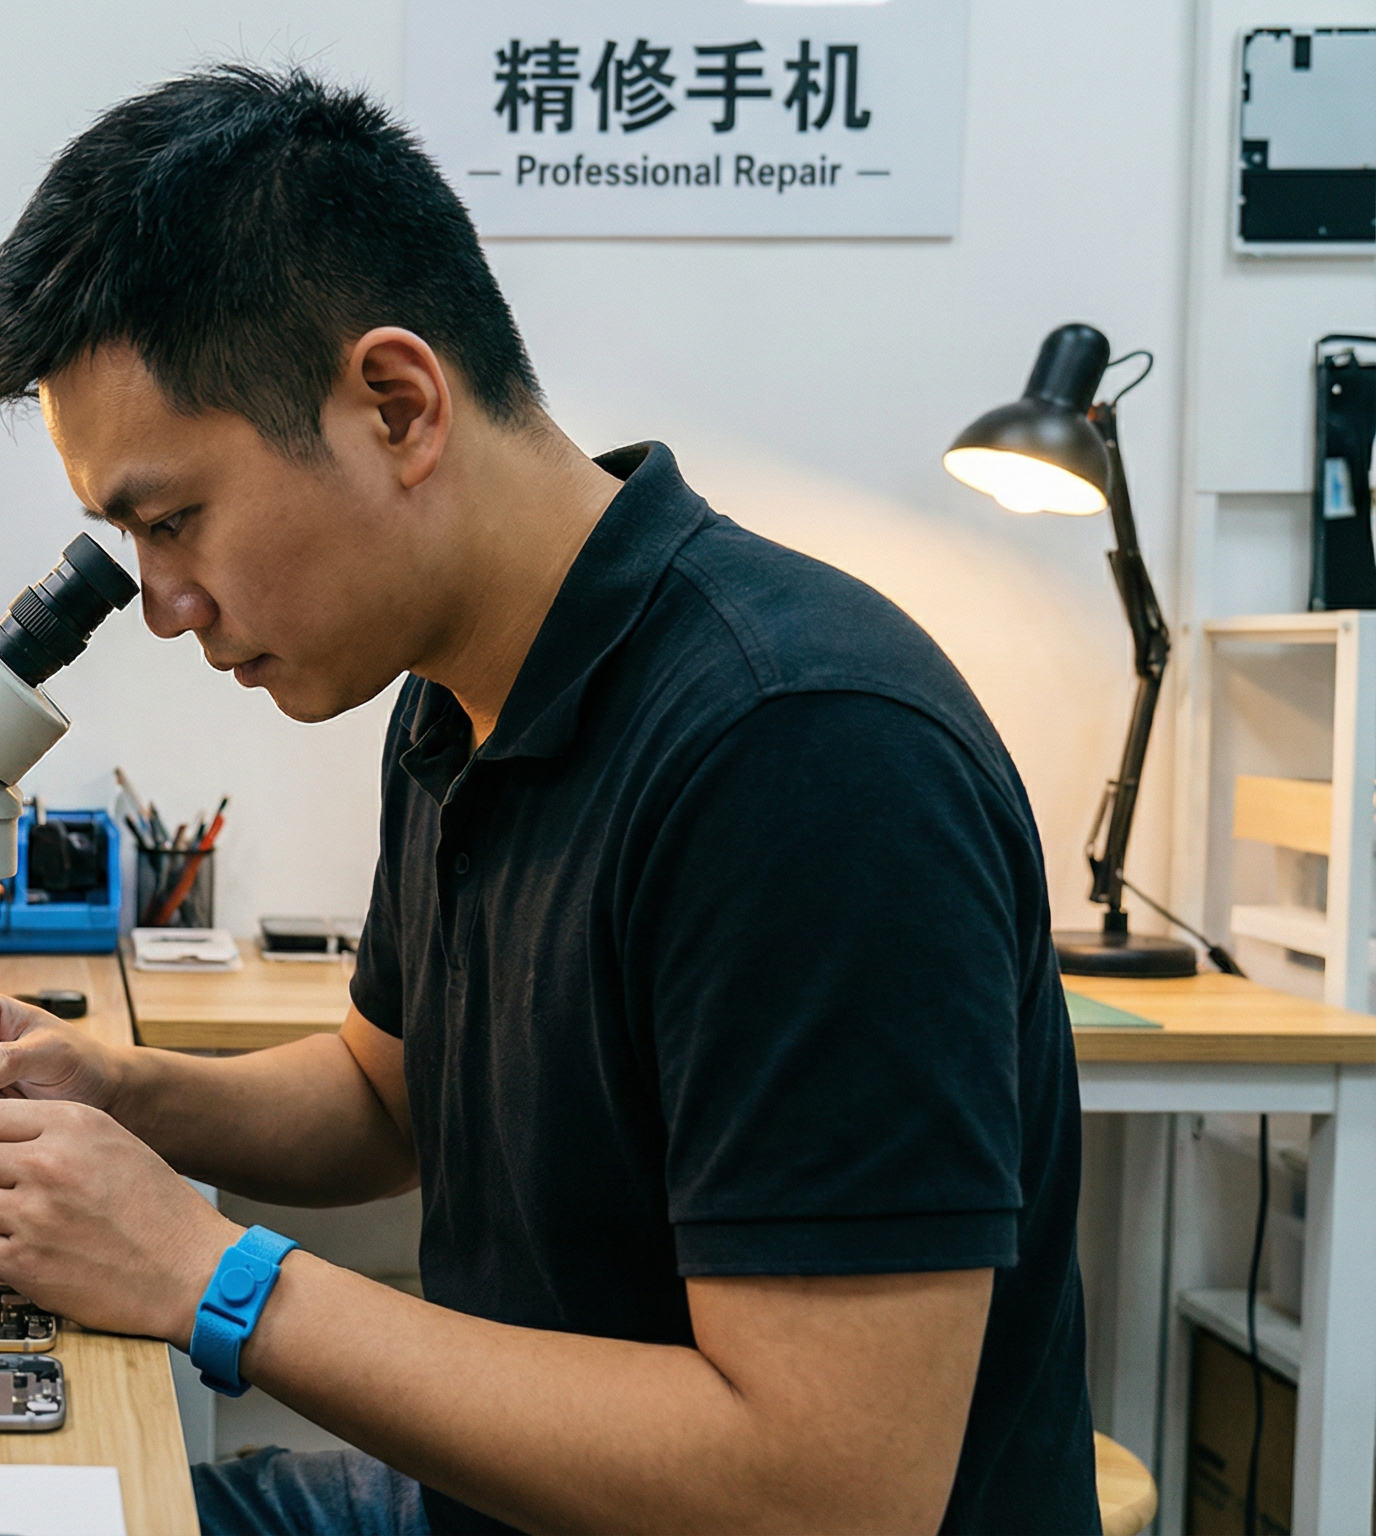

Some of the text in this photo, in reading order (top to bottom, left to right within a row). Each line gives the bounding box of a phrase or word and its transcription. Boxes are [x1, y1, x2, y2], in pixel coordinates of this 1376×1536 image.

[494, 38, 871, 134] 精修手机
[517, 154, 841, 193] Professional Repair
